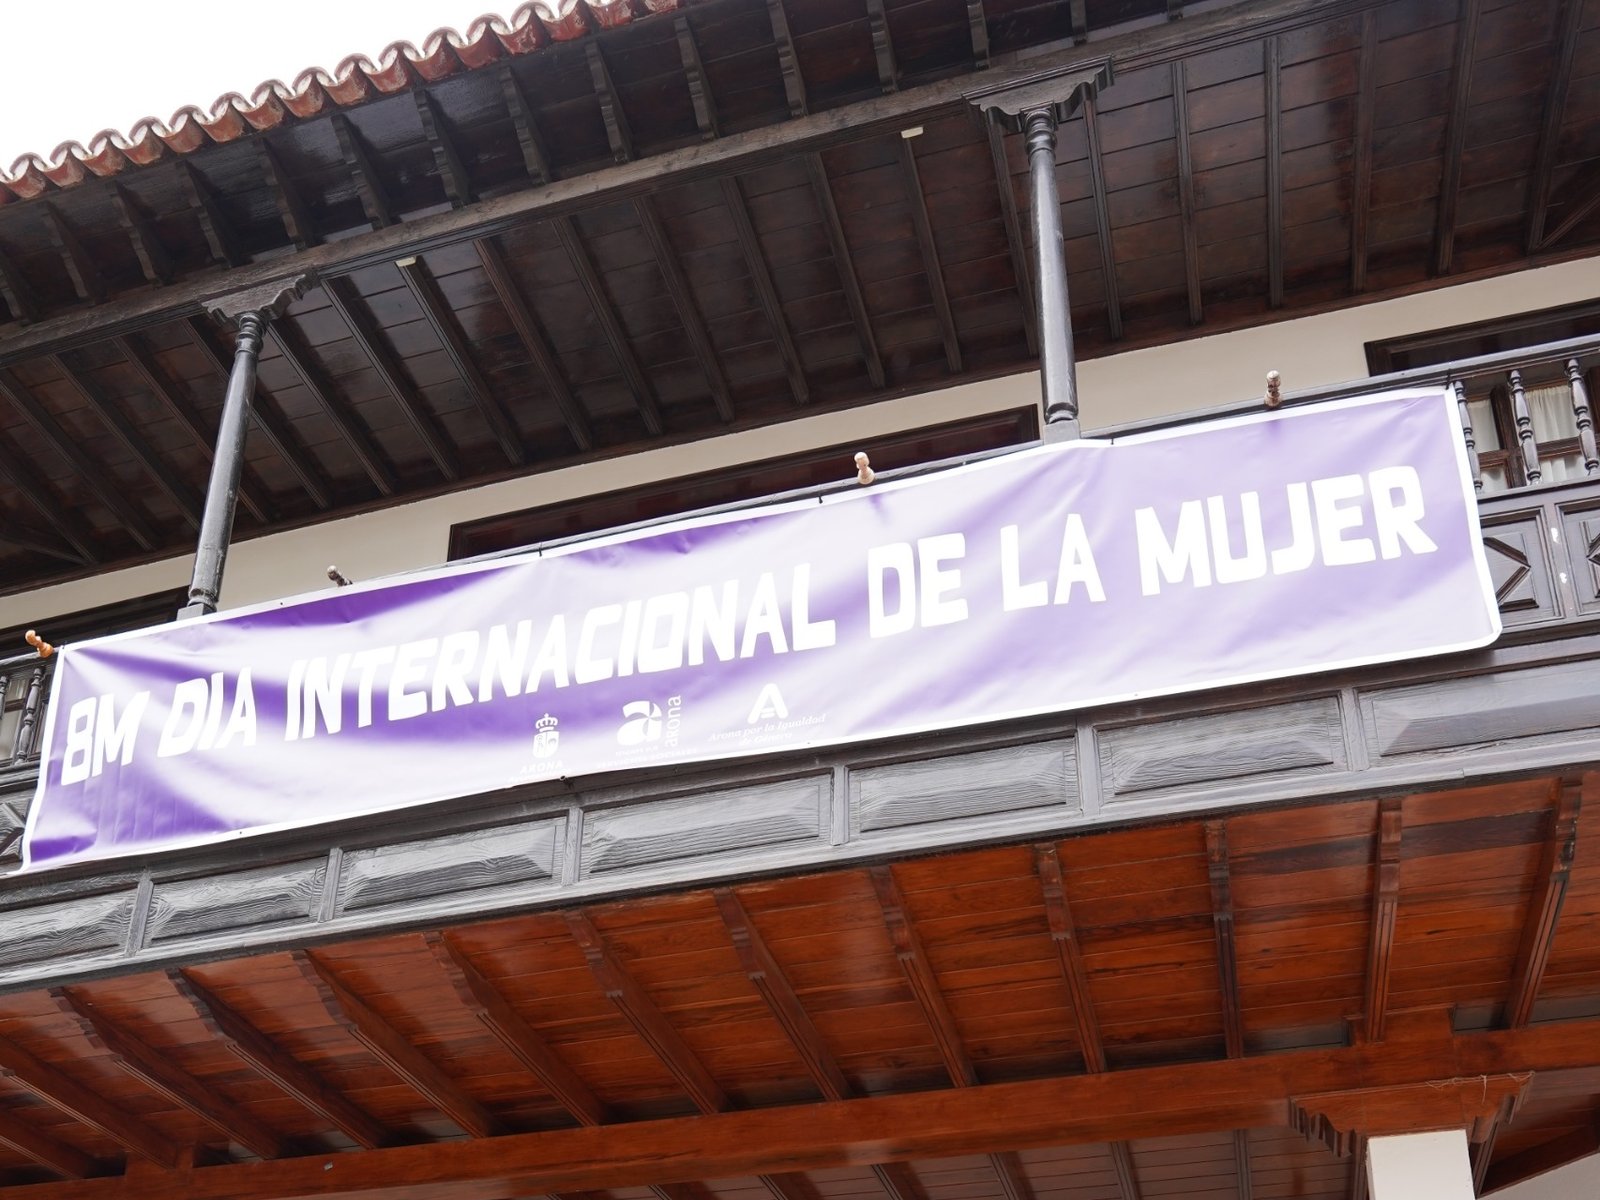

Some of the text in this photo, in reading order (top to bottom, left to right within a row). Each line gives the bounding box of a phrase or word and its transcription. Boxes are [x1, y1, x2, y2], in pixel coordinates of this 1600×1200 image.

[61, 465, 1438, 785] 8M DIA INTERNACIONAL DE LA MUJER
